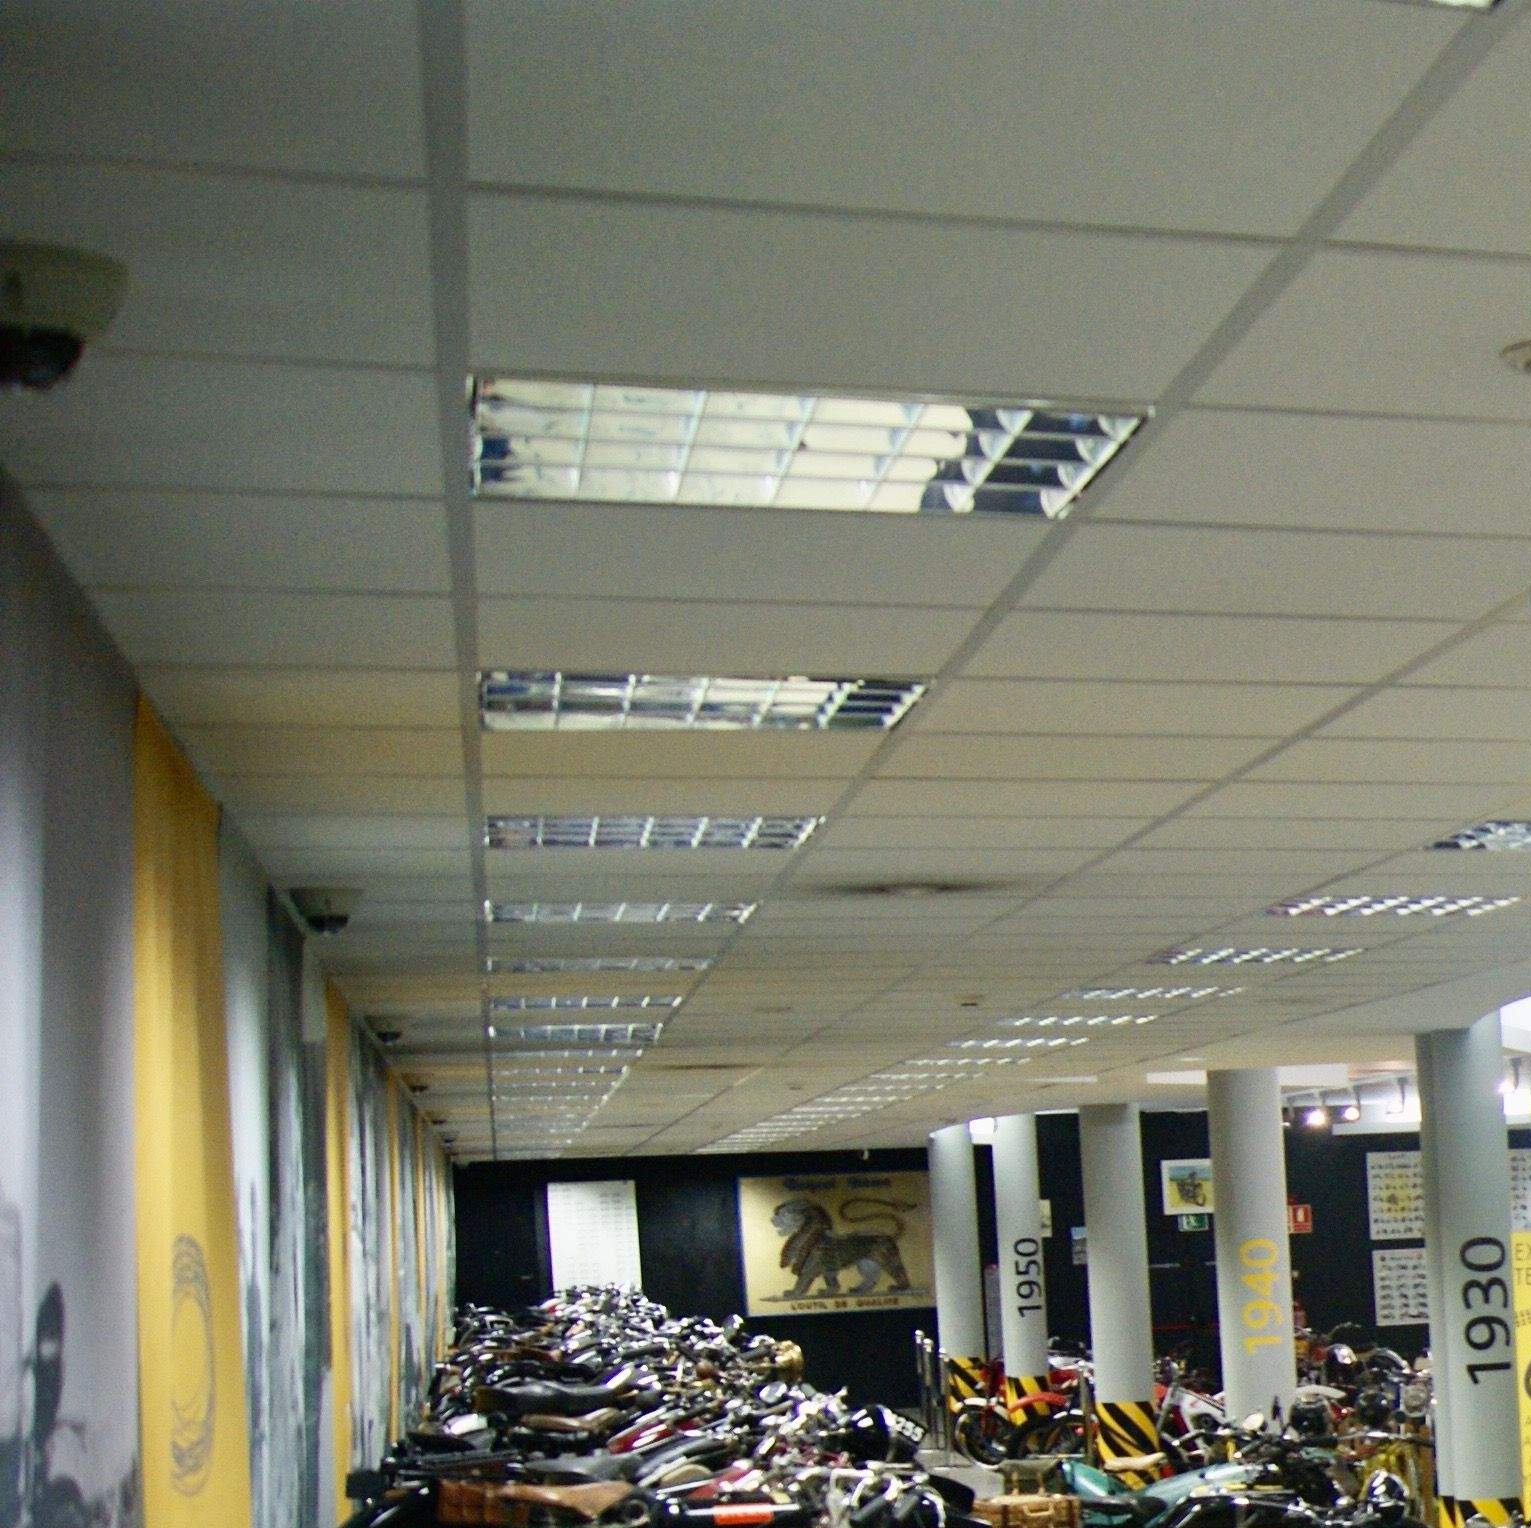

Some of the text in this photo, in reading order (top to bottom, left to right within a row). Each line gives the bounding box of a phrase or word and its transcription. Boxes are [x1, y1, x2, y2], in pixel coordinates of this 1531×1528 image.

[1014, 1238, 1042, 1318] 1950
[1238, 1238, 1283, 1357] 1940
[1460, 1236, 1512, 1384] 1930
